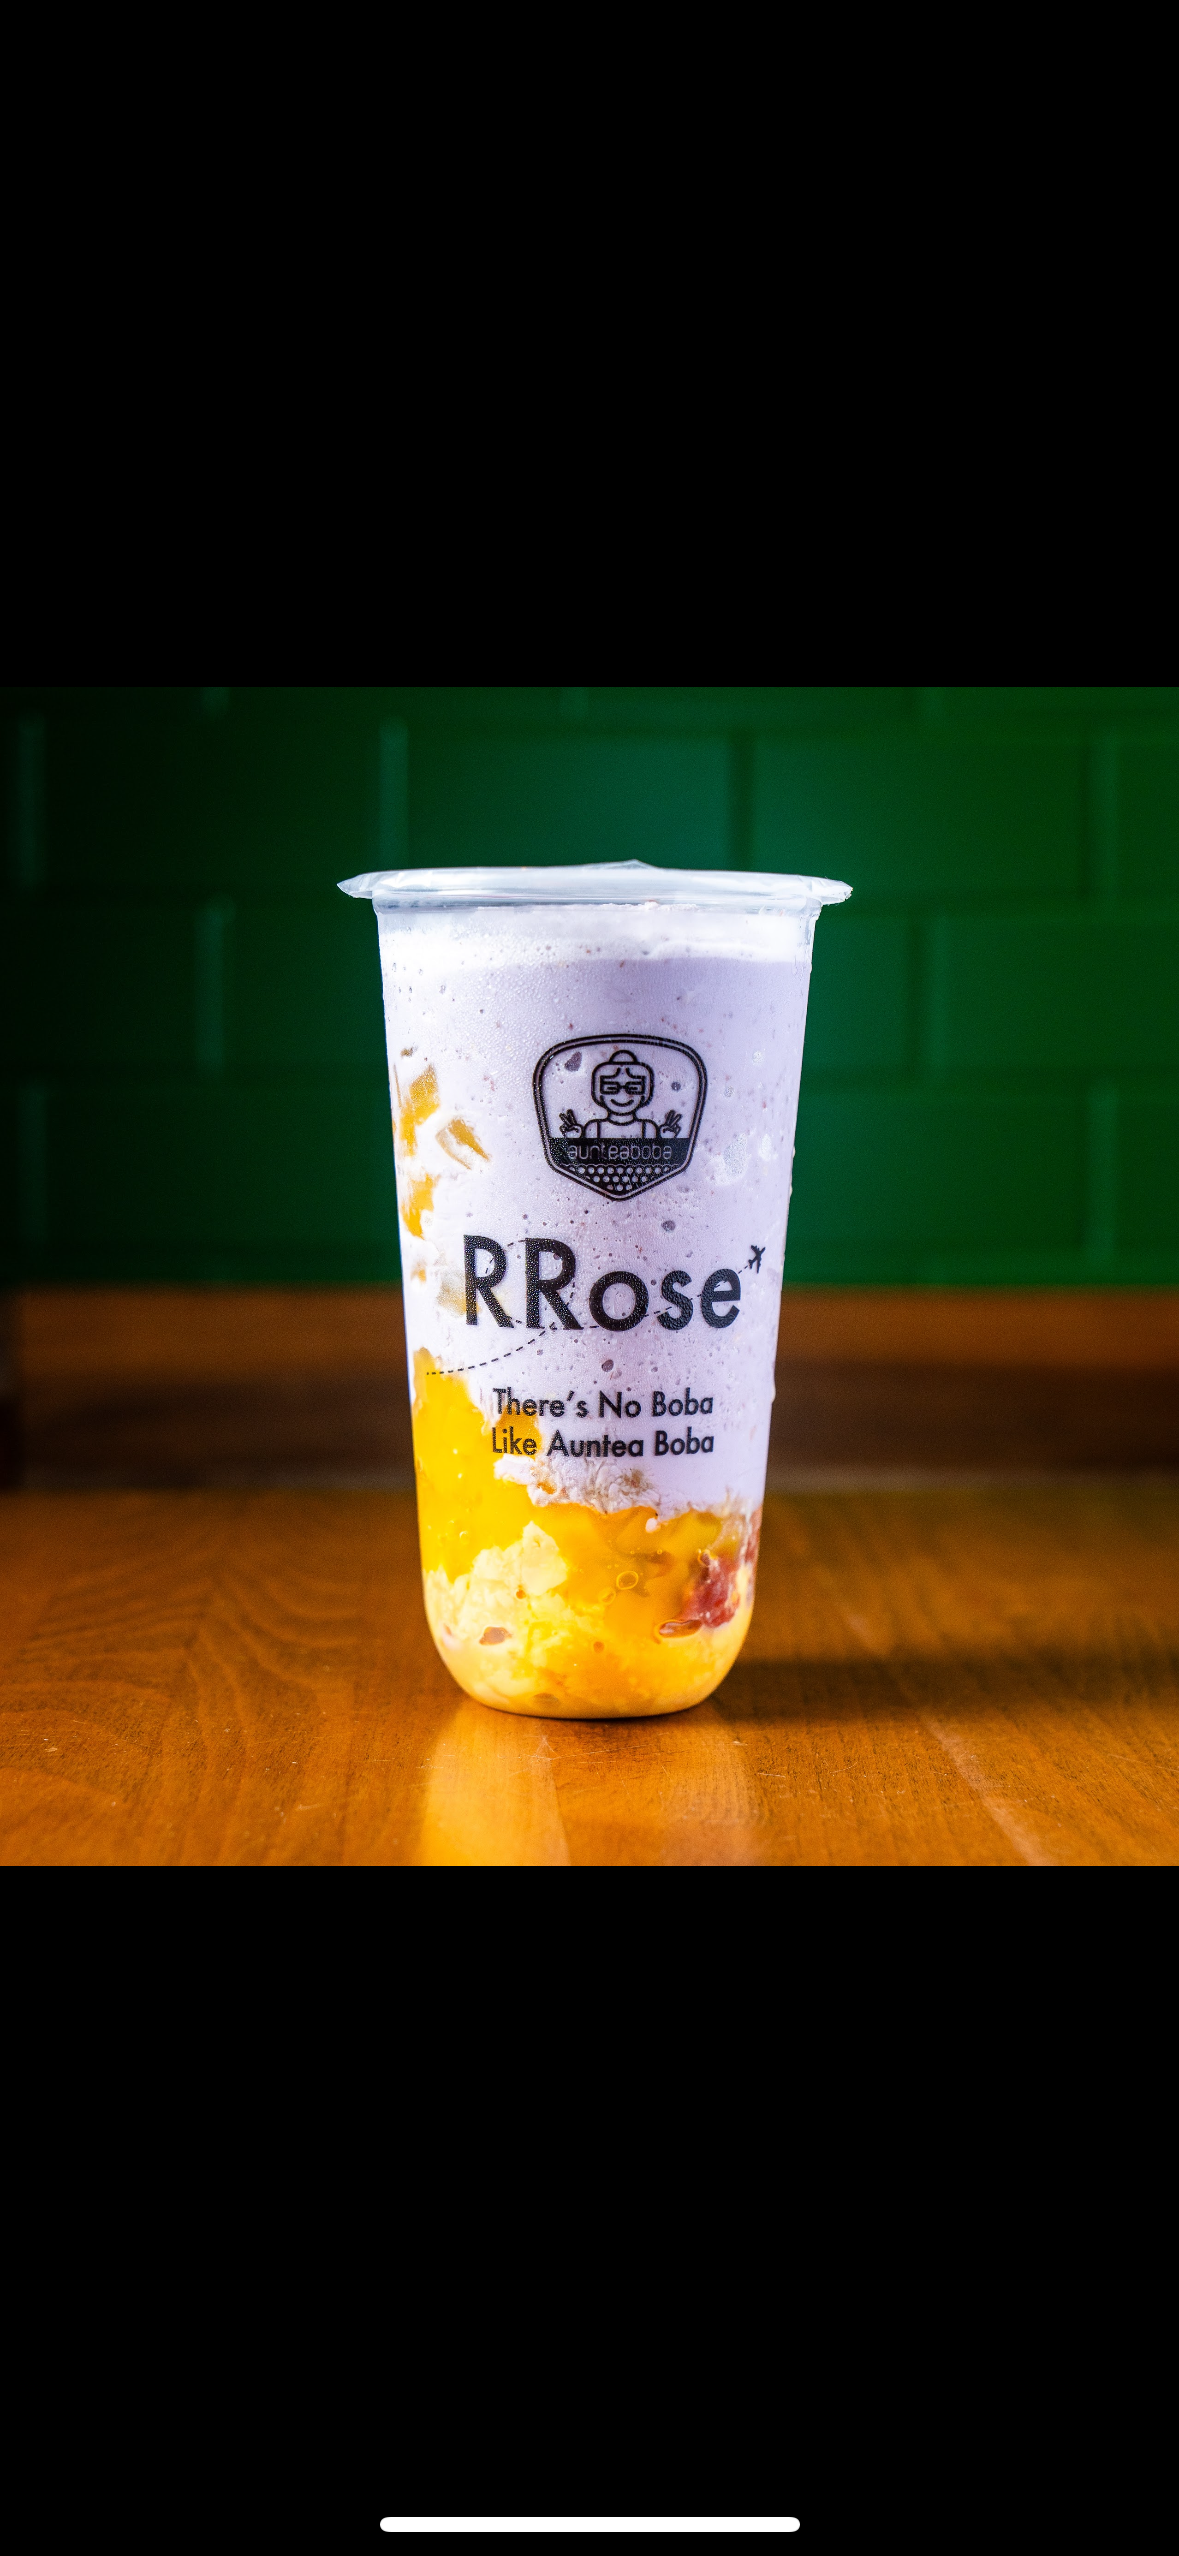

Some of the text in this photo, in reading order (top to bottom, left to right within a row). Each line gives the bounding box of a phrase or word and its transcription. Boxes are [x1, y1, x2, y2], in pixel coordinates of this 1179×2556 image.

[567, 1141, 672, 1160] aunteaboba
[463, 1234, 742, 1331] RRose
[493, 1387, 714, 1418] There's No Boba
[492, 1426, 715, 1458] Like Auntea Boba
